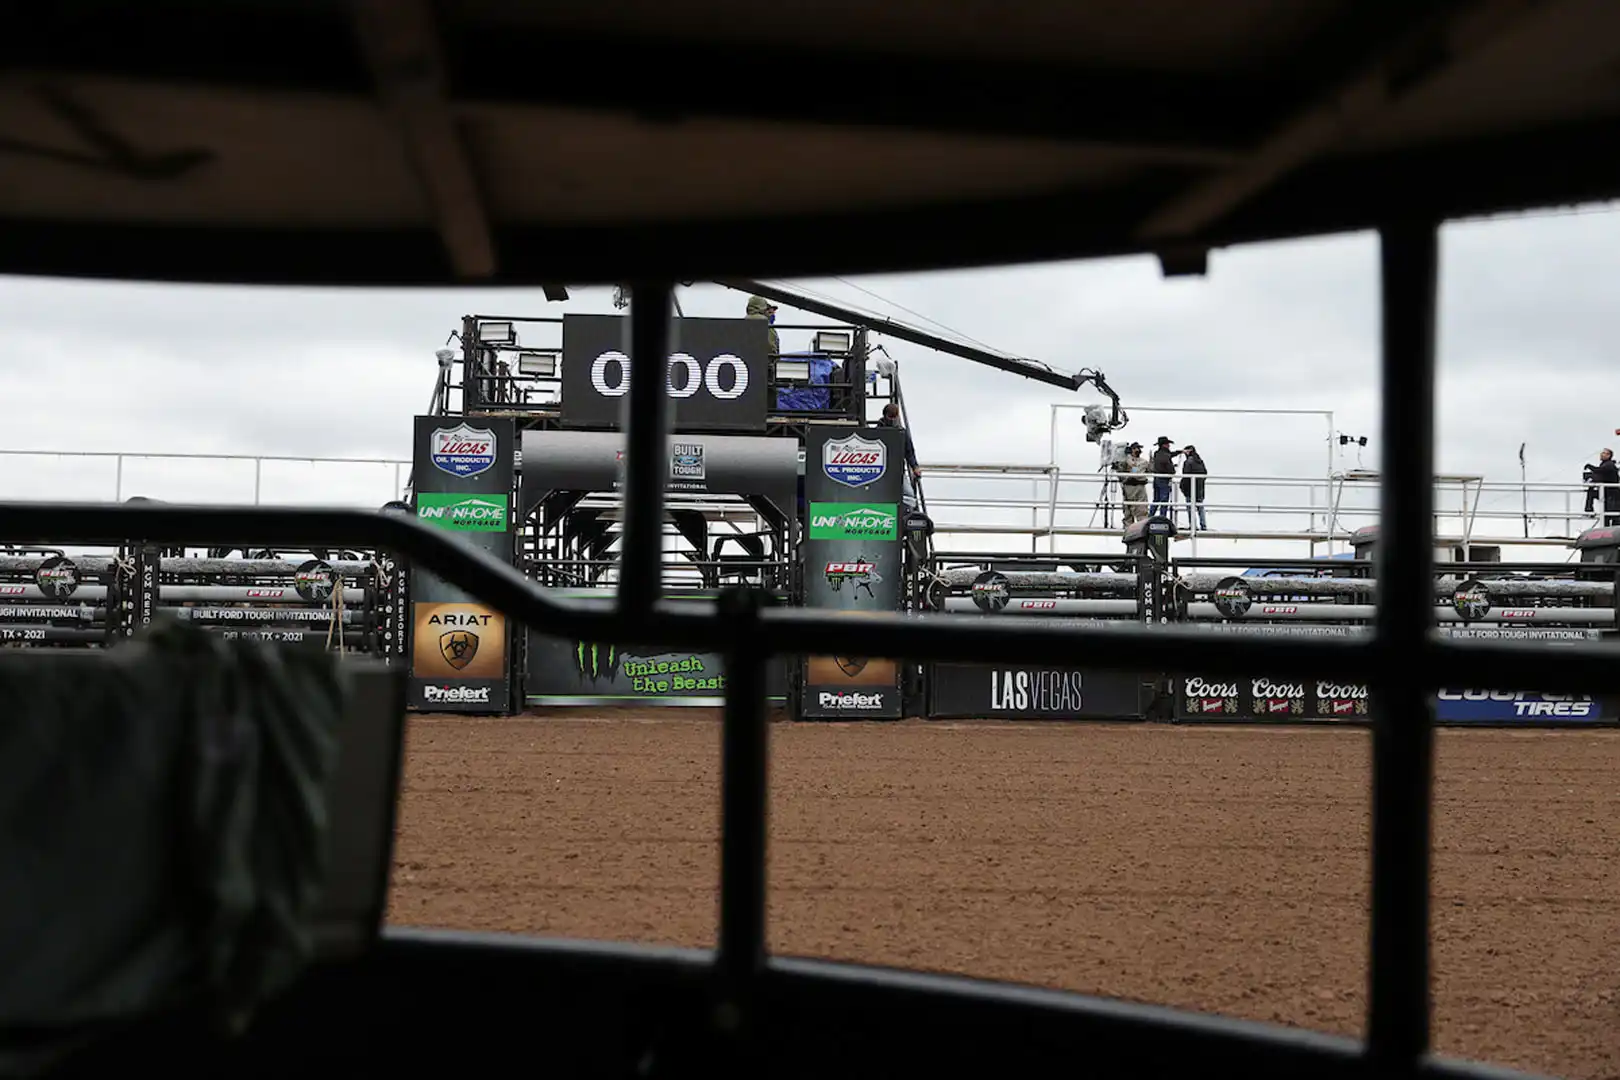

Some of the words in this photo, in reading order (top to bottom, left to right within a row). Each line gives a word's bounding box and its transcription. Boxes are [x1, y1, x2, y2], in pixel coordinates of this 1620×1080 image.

[440, 441, 490, 454] LUCAS
[675, 445, 703, 455] BUILT
[831, 452, 879, 464] LUCAS
[674, 465, 702, 475] TOUGH
[842, 466, 881, 474] PRODUCTS
[827, 562, 875, 573] PBR
[398, 571, 406, 594] MGM
[247, 589, 284, 597] PBR
[1144, 583, 1153, 605] MGM
[17, 608, 78, 618] INVITATIONAL
[193, 610, 218, 619] BUILT
[219, 610, 243, 620] FORD
[244, 611, 274, 620] TOUGH
[428, 614, 492, 626] ARIAT
[3, 629, 15, 639] TX
[24, 630, 46, 639] 2021
[261, 632, 273, 641] TX
[282, 632, 304, 641] 2021
[1476, 631, 1499, 639] FORD
[1500, 631, 1528, 639] TOUGH
[1529, 631, 1585, 640] INVITATIONAL
[624, 655, 704, 676] Unleash
[633, 676, 669, 692] the
[673, 674, 727, 690] Beast
[1185, 677, 1238, 698] Coors
[1251, 677, 1304, 698] Coors
[1316, 678, 1368, 699] Coors
[424, 684, 490, 699] Priefert
[819, 691, 882, 705] Priefert
[1513, 701, 1592, 716] TIRES
